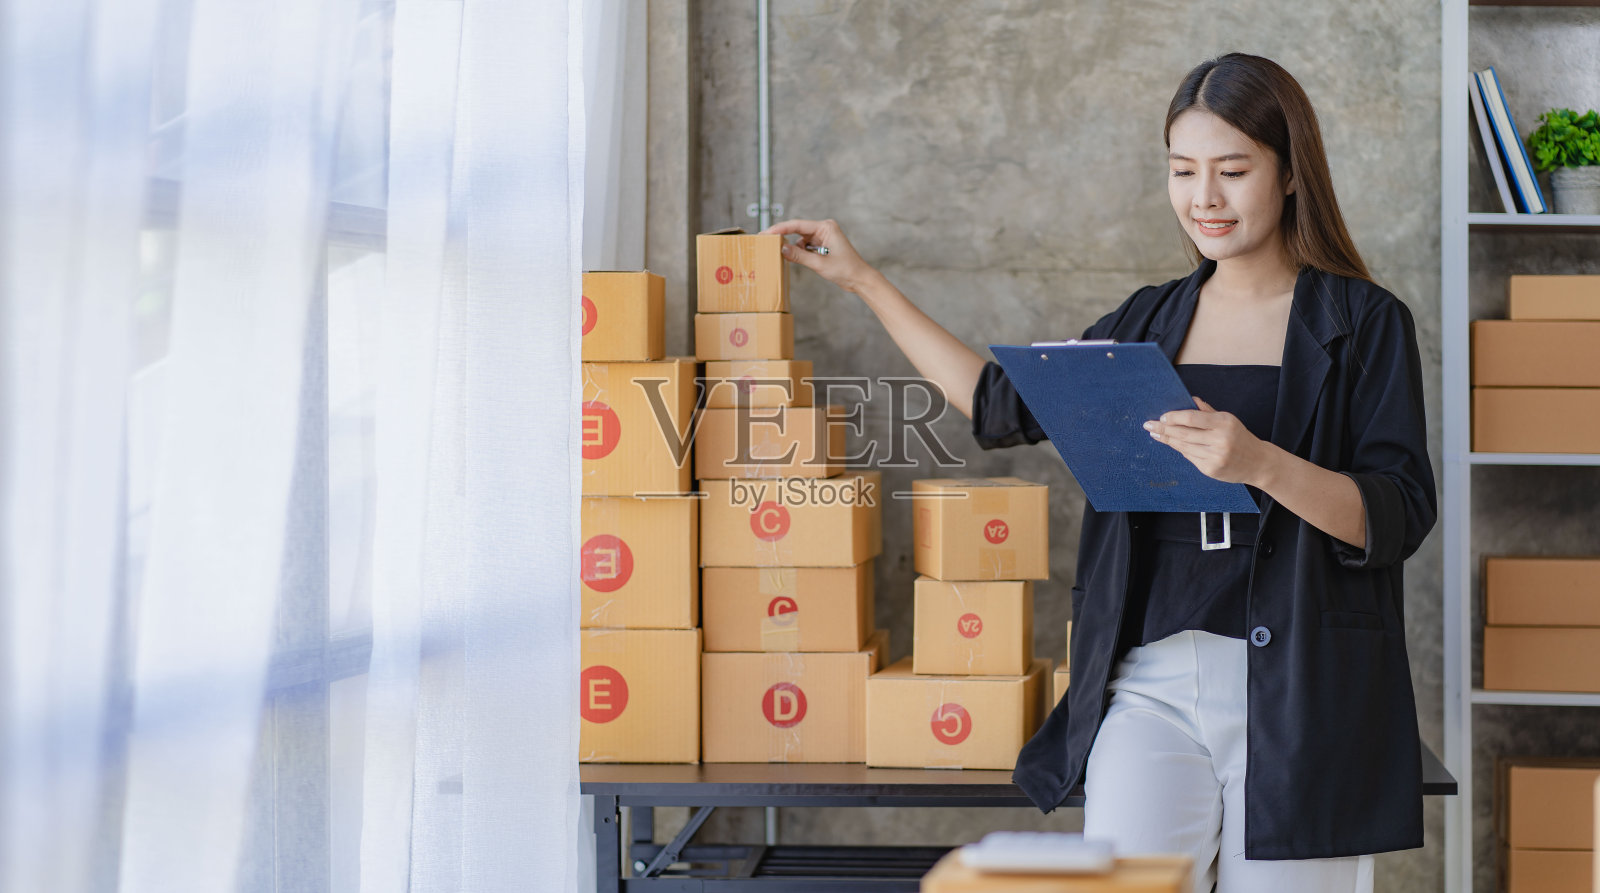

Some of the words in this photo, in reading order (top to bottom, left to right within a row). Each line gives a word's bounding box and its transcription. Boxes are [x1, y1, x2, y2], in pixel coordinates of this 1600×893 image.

[582, 415, 603, 446] E
[759, 509, 781, 534] C
[987, 525, 1006, 538] 2A
[594, 548, 616, 579] E
[960, 619, 980, 633] 2A
[588, 678, 612, 710] E
[773, 689, 799, 721] D
[940, 711, 963, 738] C
